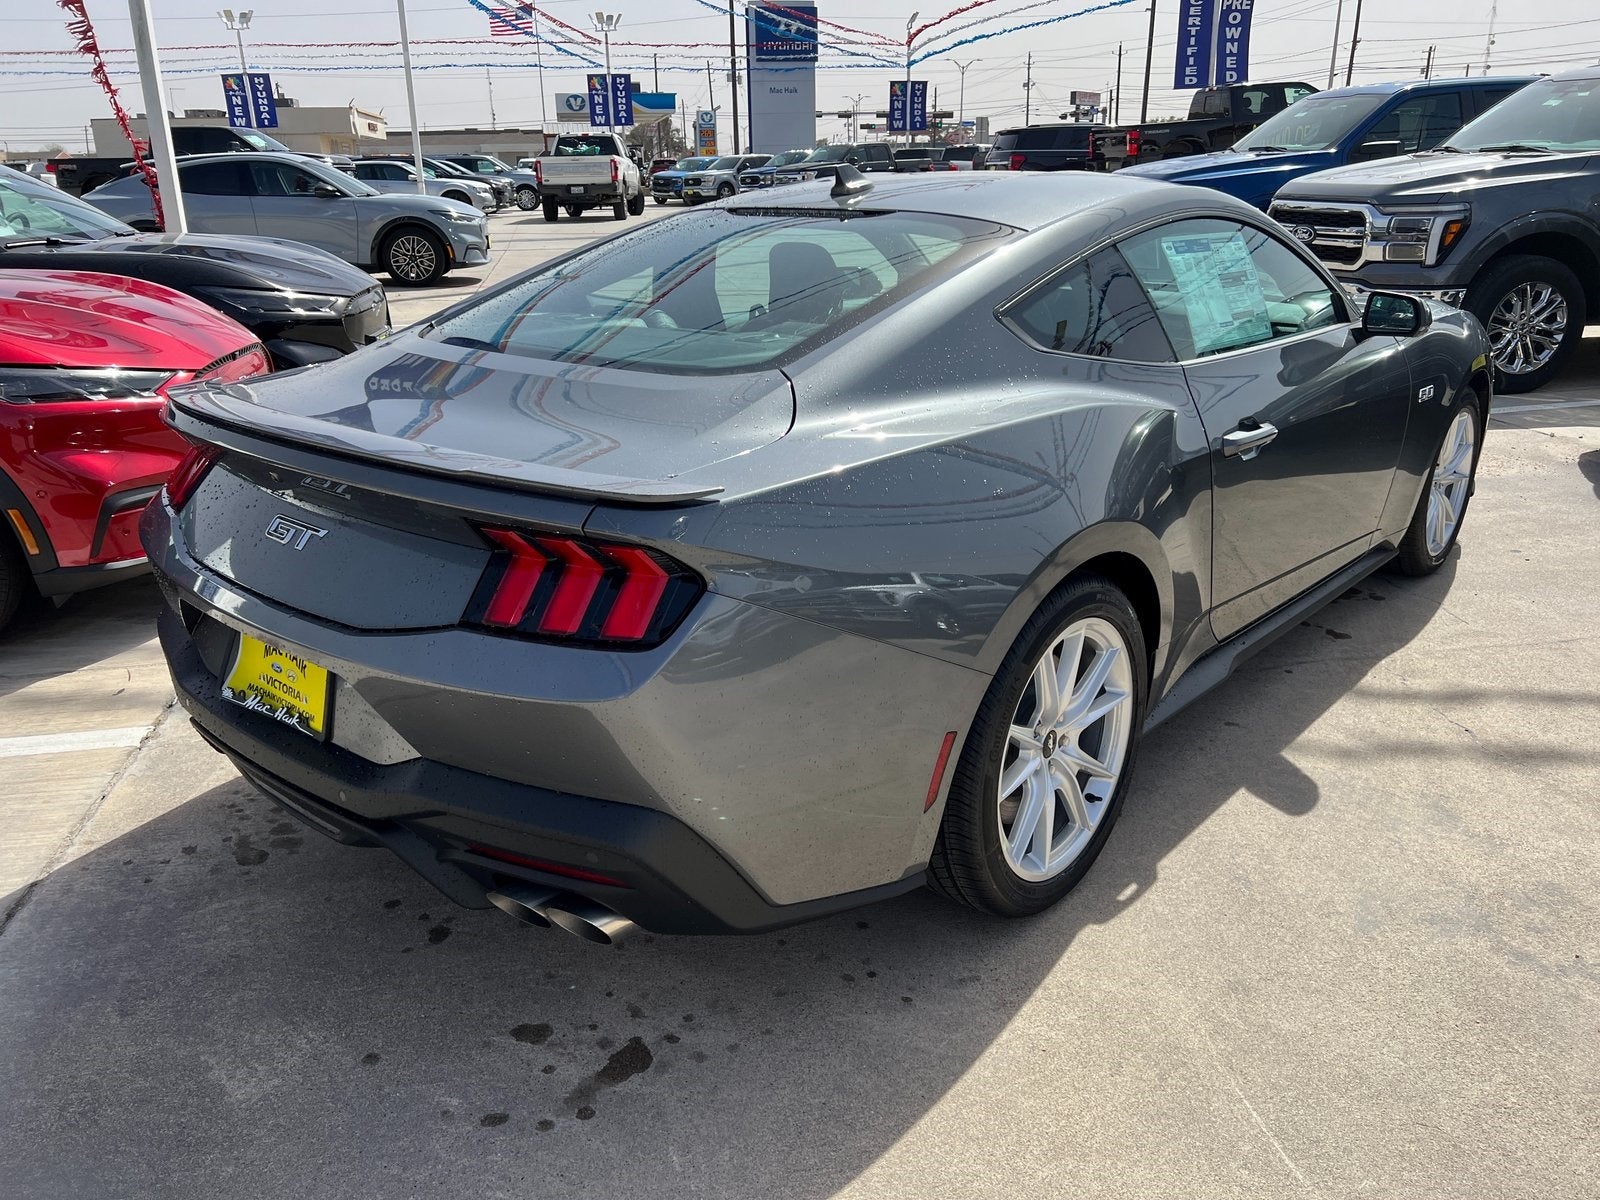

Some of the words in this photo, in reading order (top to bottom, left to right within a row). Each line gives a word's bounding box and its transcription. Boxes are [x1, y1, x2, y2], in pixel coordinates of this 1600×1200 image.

[1222, 0, 1251, 10] PRE
[763, 41, 813, 51] HYUNDAI
[1184, 0, 1203, 85] CERTIFIED
[1225, 12, 1242, 83] OWNED
[254, 77, 271, 126] HYUNDAI
[616, 77, 627, 124] HYUNDAI
[784, 86, 798, 94] Haik
[914, 83, 923, 128] HYUNDAI
[231, 95, 246, 127] NEW
[594, 94, 606, 124] NEW
[893, 100, 903, 129] NEW
[265, 514, 329, 551] GT
[265, 674, 301, 701] VICTORIA
[243, 694, 273, 715] Mac
